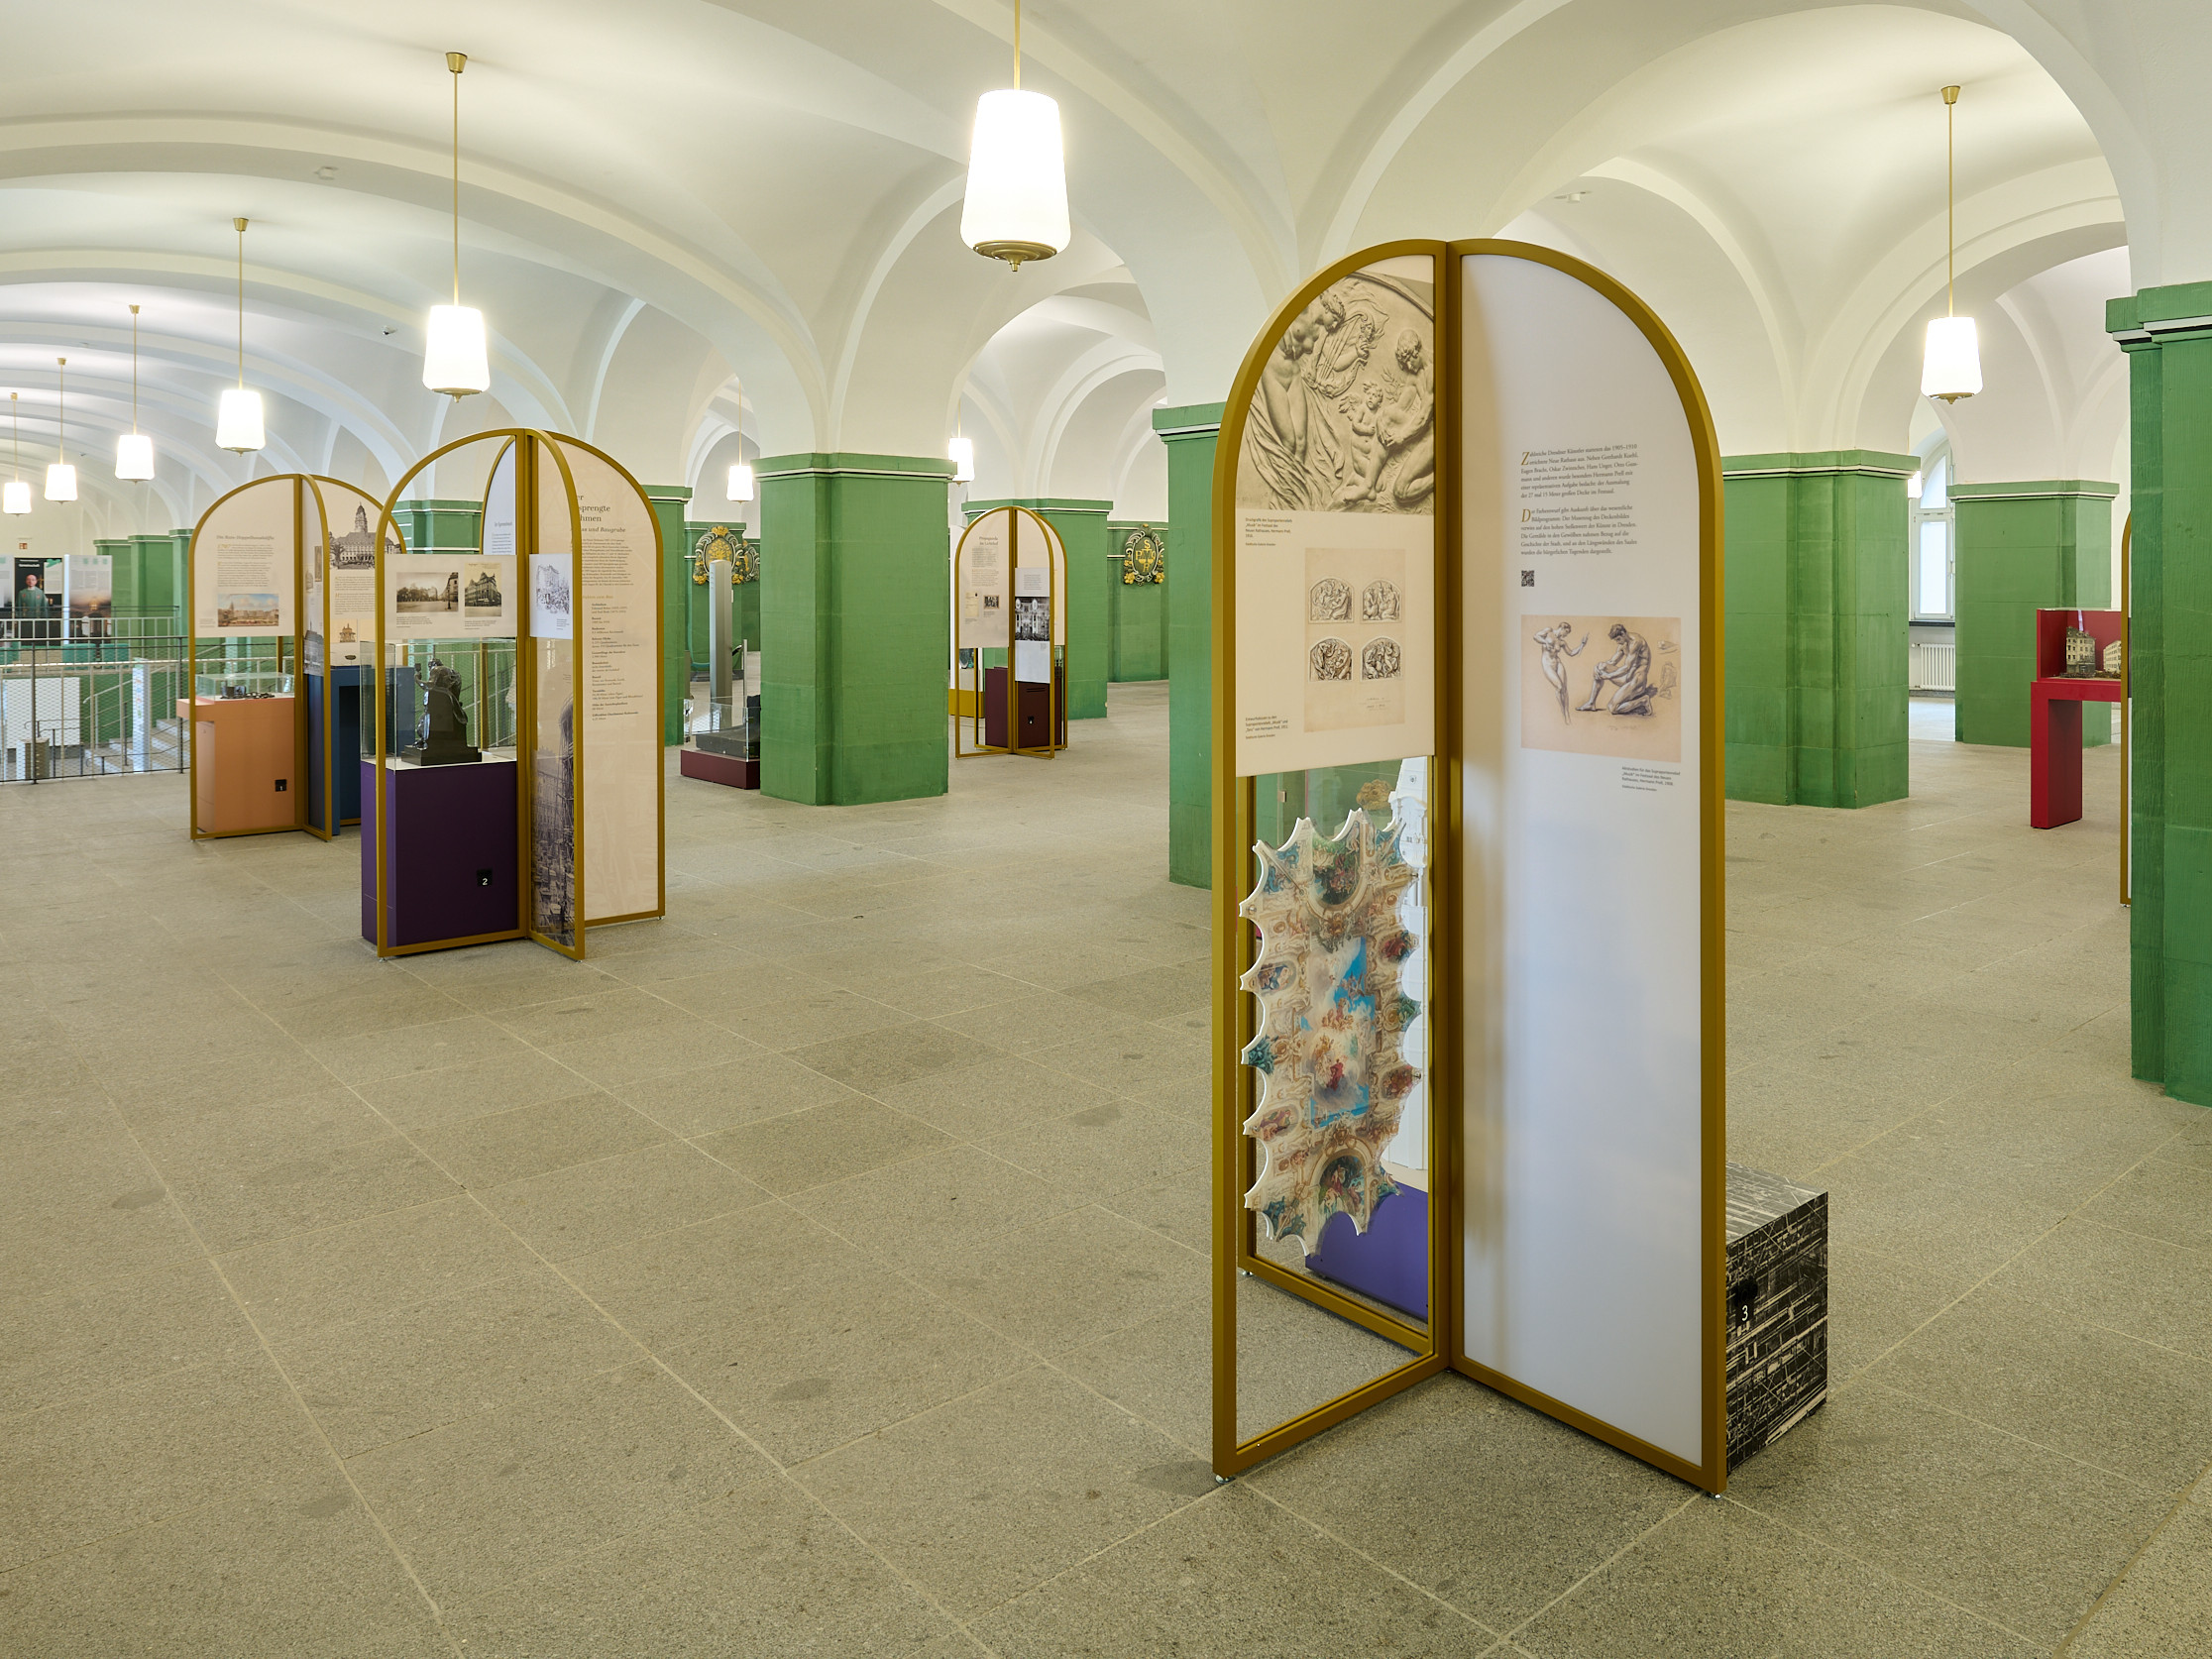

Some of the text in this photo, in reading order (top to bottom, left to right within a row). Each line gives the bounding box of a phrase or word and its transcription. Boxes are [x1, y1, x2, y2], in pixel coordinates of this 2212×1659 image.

[580, 505, 610, 514] sprengte
[580, 513, 603, 522] hmen
[482, 877, 489, 886] 2
[1741, 1304, 1748, 1322] 3
